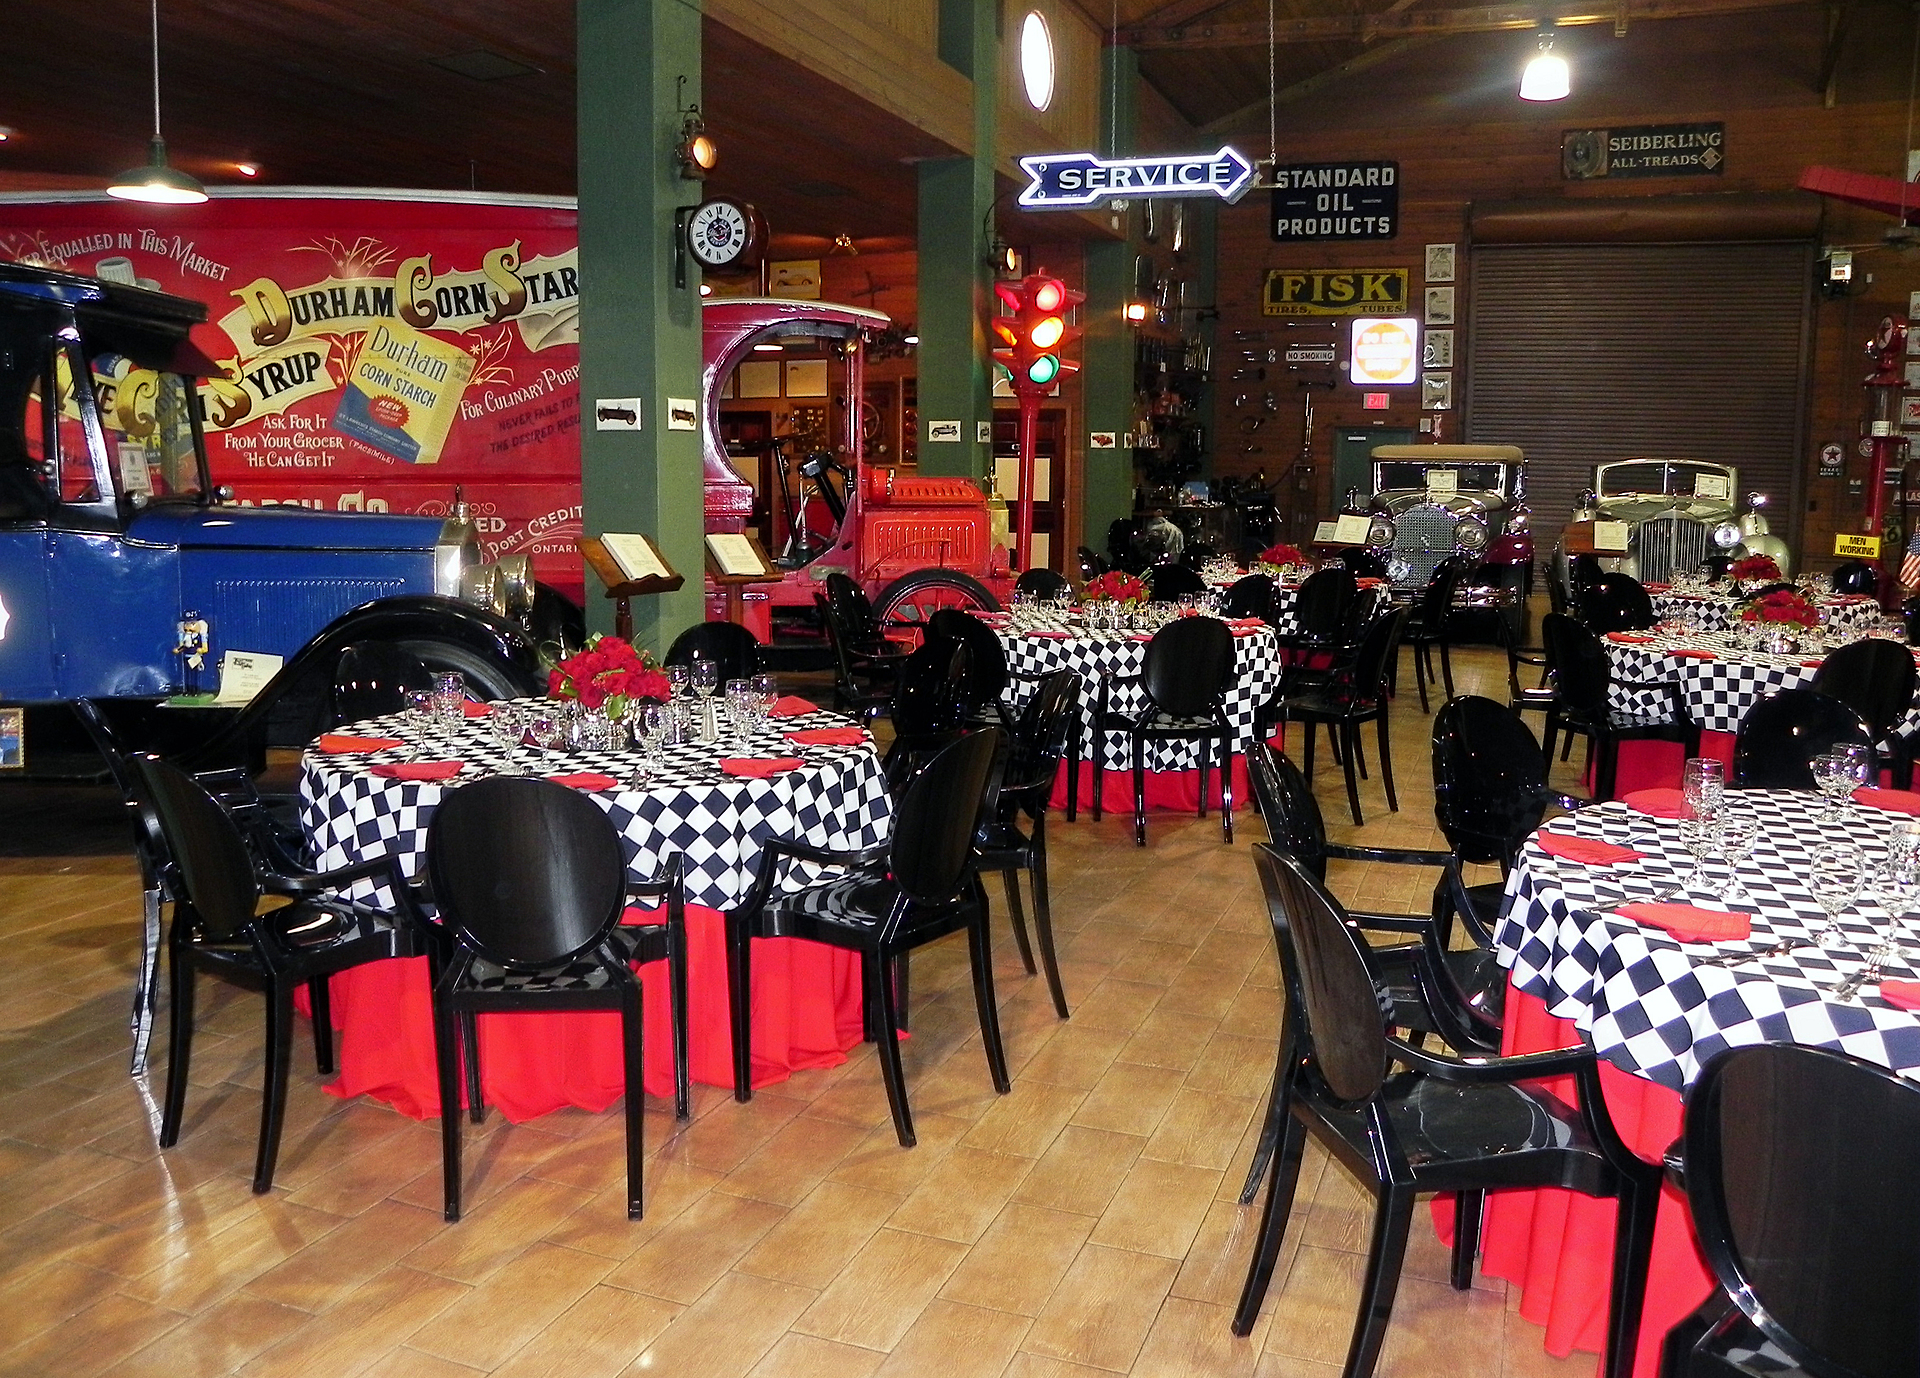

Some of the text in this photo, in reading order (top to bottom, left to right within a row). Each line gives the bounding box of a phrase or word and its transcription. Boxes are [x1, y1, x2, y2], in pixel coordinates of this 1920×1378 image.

[1609, 132, 1721, 152] SEIBERLING
[1058, 162, 1231, 190] SERVICE
[1276, 167, 1394, 189] STANDARD
[1316, 193, 1354, 212] OIL
[1277, 216, 1390, 236] PRODUCTS
[118, 233, 132, 249] IN
[137, 228, 168, 255] THIS
[170, 235, 230, 281] MARKET
[230, 238, 579, 347] DURHAM CORN STAR
[1280, 274, 1393, 302] FISK
[369, 325, 448, 383] Durham
[1287, 350, 1333, 360] NO SMOKING
[211, 351, 322, 428] SYRUP
[359, 362, 437, 409] CORN STARCH
[460, 364, 580, 421] FOR CULINARY PURP
[378, 399, 402, 412] NEW
[262, 415, 287, 430] ASK
[290, 414, 315, 431] FOR
[315, 413, 328, 429] IT
[225, 431, 345, 451] FROM YOUR GROCER
[243, 451, 266, 467] HE
[266, 450, 292, 467] CAN
[321, 450, 336, 467] IT
[487, 505, 583, 559] PORT CREDIT
[1849, 536, 1866, 546] MEN
[532, 544, 578, 554] ONTARI
[1839, 545, 1875, 556] WORKING
